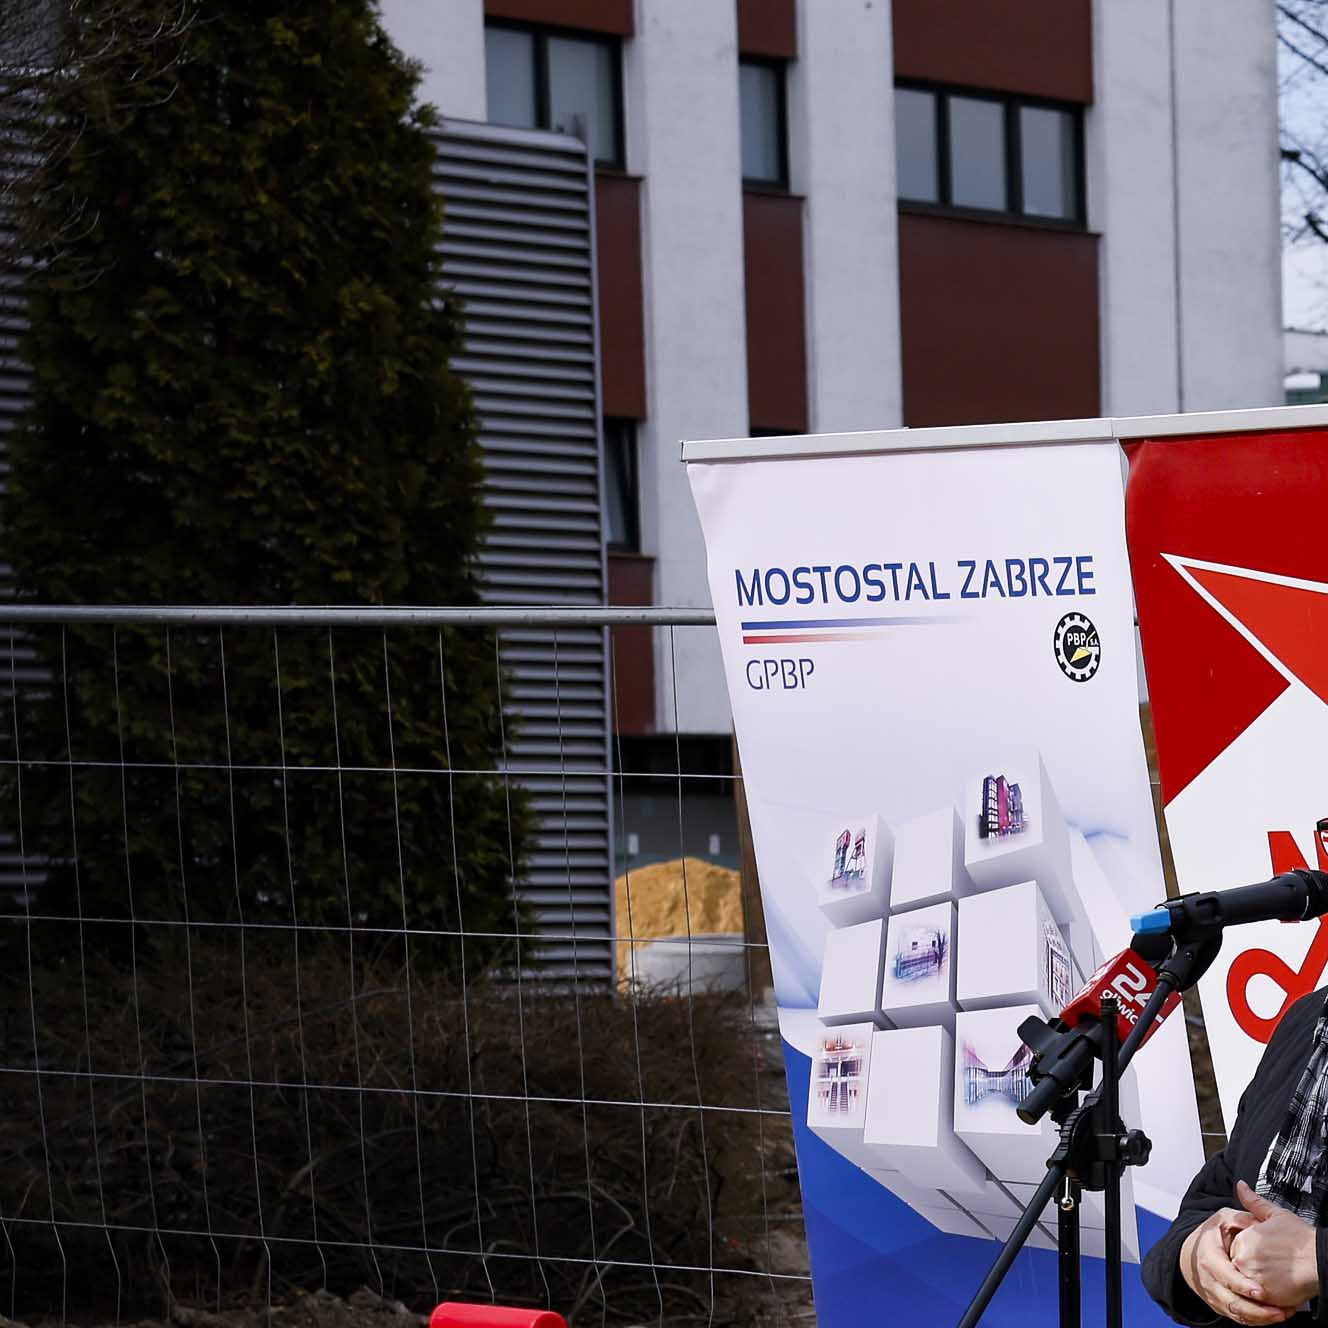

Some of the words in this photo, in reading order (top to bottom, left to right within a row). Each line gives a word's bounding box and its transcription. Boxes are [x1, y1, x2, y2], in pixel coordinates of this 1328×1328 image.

[735, 562, 951, 607] MOSTOSTAL
[957, 555, 1097, 599] ZABRZE
[1066, 632, 1087, 646] PBP
[745, 658, 815, 690] GPBP
